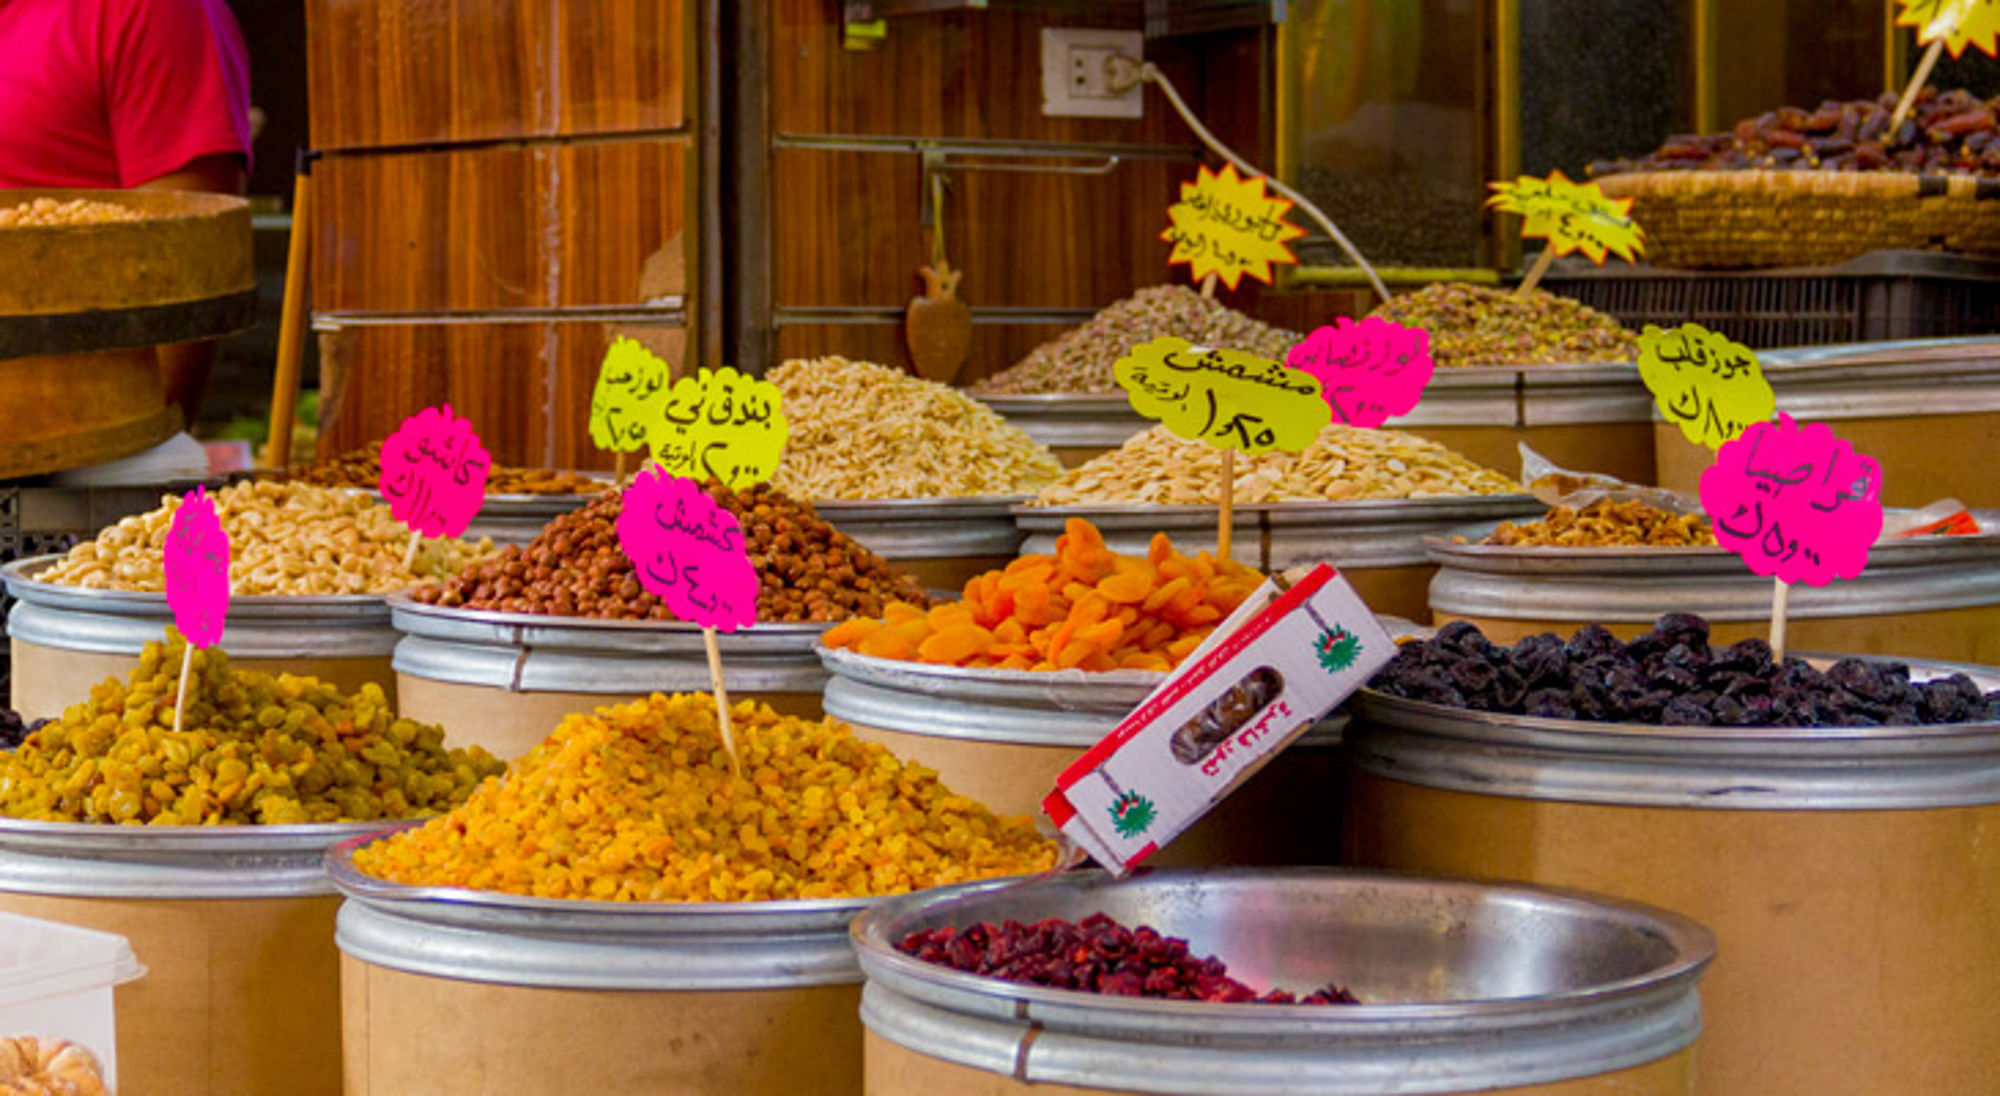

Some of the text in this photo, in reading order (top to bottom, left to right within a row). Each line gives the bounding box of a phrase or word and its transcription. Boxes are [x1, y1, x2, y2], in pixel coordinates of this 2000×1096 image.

[1162, 350, 1316, 396] مشمش
[1654, 335, 1752, 380] جوز قلب
[706, 384, 772, 430] بندق
[654, 498, 742, 552] كشمش
